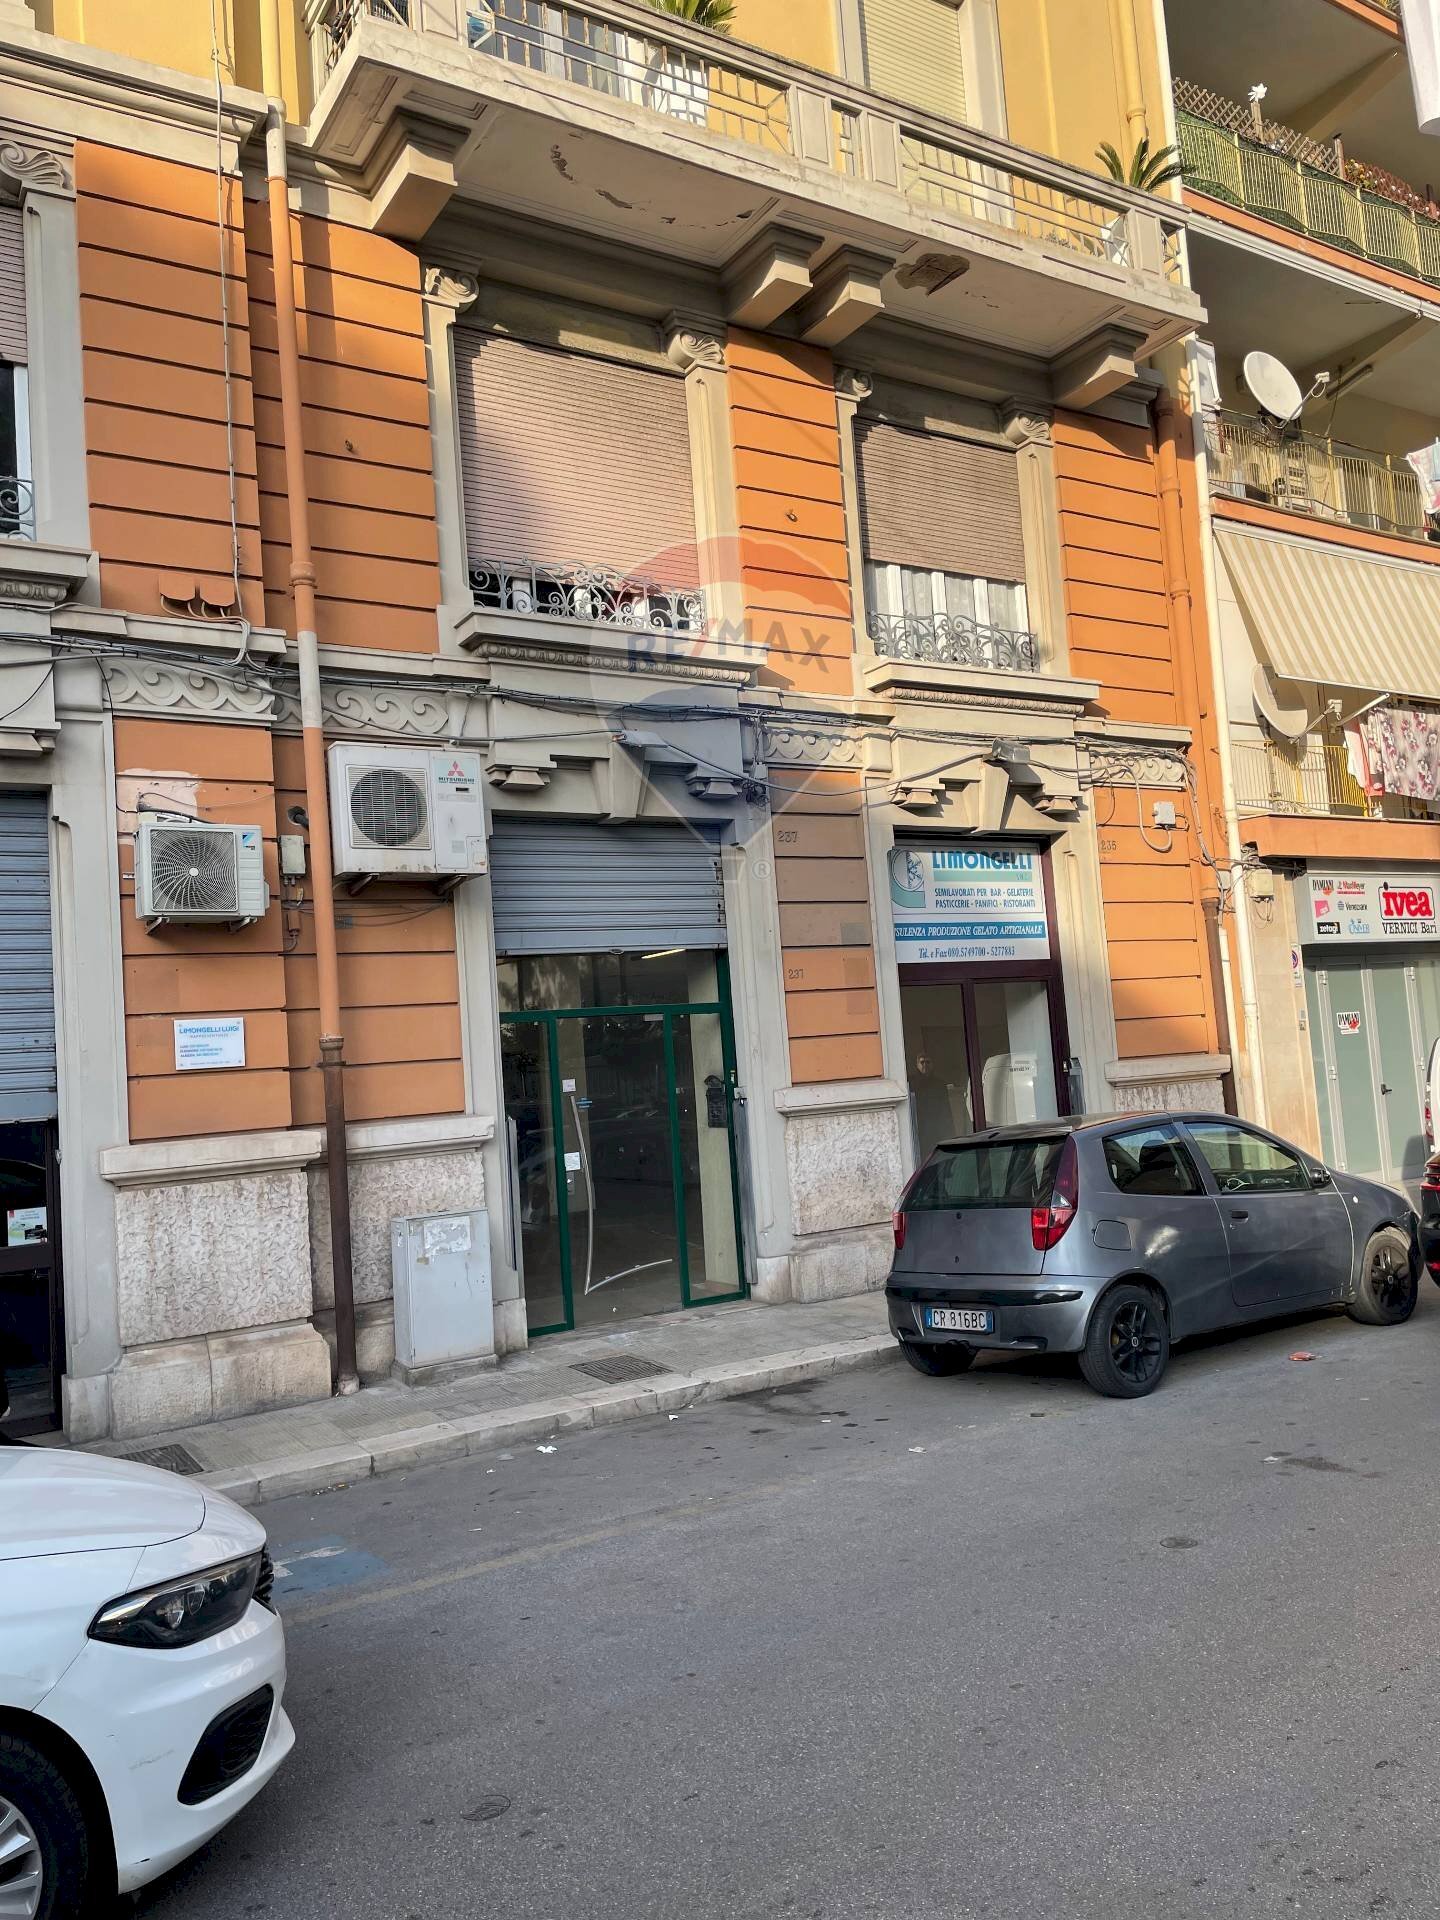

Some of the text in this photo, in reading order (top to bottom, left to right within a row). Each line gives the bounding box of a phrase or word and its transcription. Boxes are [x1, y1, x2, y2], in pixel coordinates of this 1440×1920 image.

[777, 830, 798, 843] 237
[1100, 840, 1117, 851] 235
[934, 888, 975, 897] SEMILAVORATI
[976, 888, 987, 897] PER
[990, 888, 1002, 897] BAR
[1007, 888, 1034, 897] GELATERIE
[935, 899, 970, 909] PASTICCERIE
[974, 899, 998, 908] PANIFICI
[1003, 899, 1036, 908] RISTORANTI
[1382, 881, 1433, 917] ivea
[927, 926, 971, 936] PRODUZIONE
[972, 925, 998, 936] GELATO
[999, 924, 1043, 935] ARTIGIANALE
[1382, 921, 1437, 935] VERNICI Bari
[935, 947, 947, 959] Fax
[787, 968, 804, 980] 237
[179, 1026, 221, 1034] LIMONGELLI
[933, 1310, 986, 1329] CR 816BC
